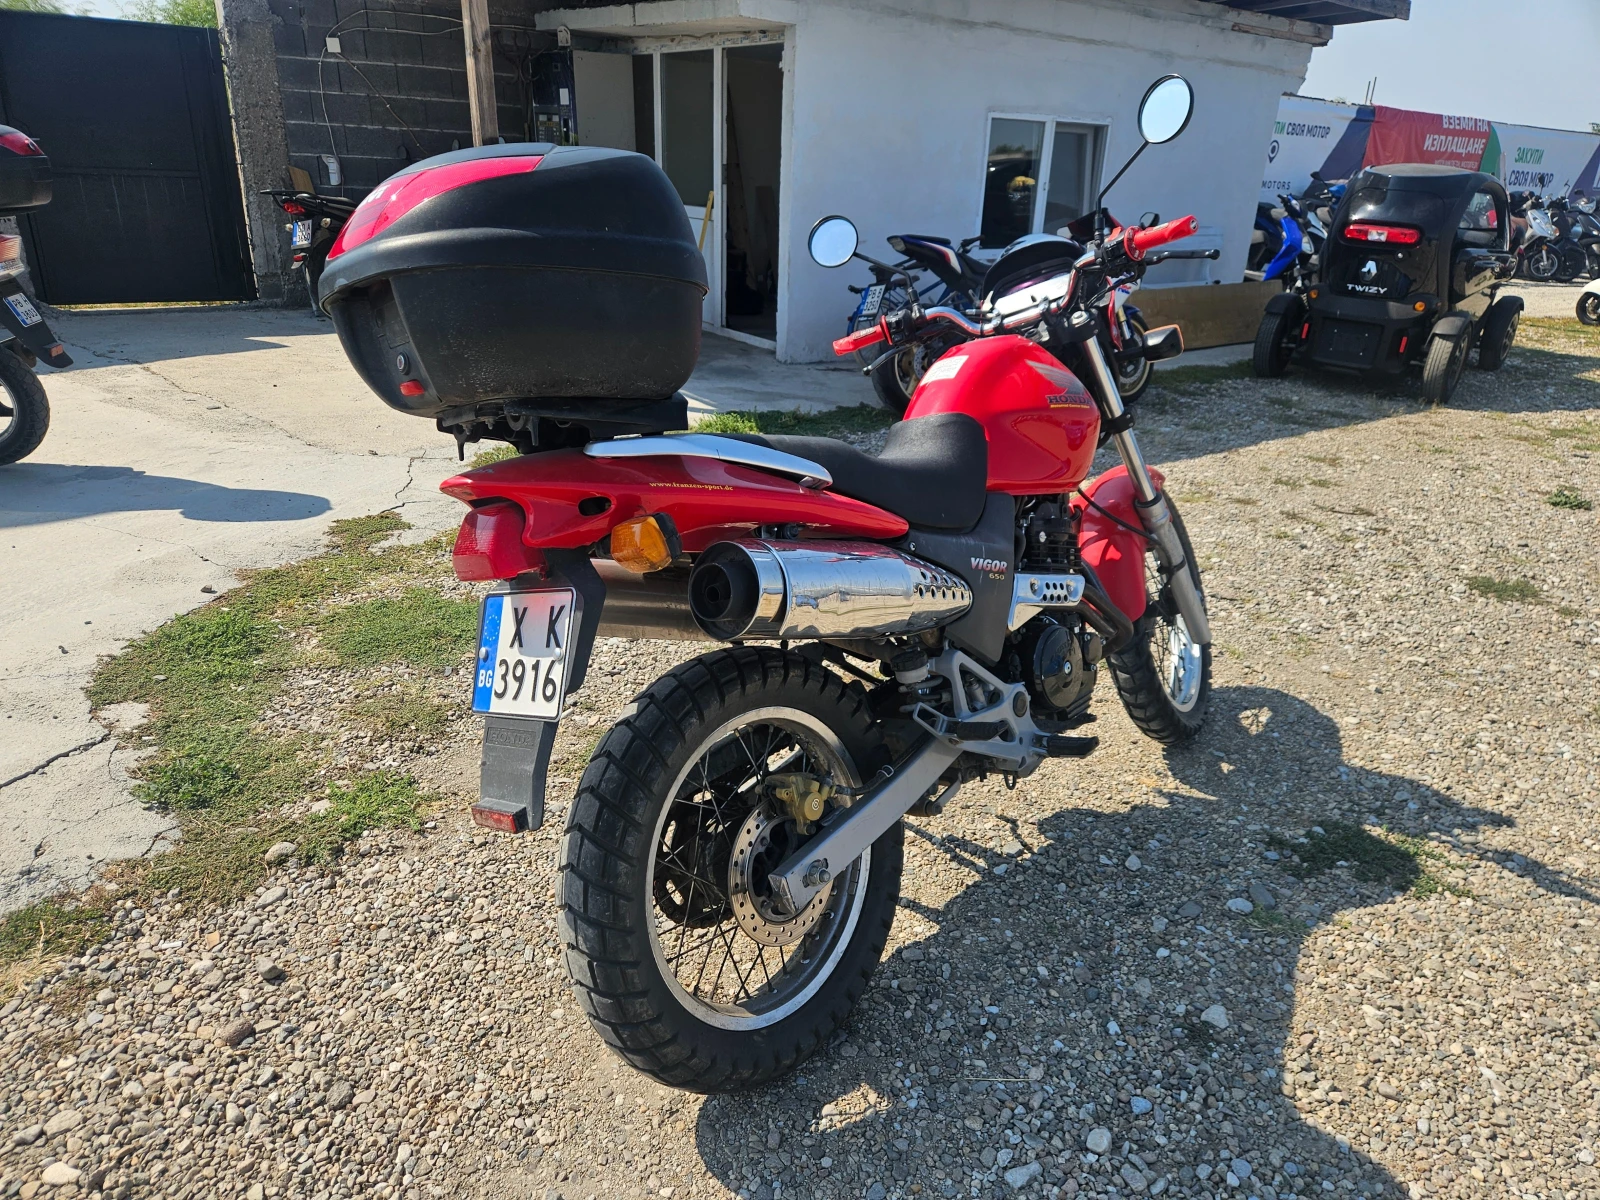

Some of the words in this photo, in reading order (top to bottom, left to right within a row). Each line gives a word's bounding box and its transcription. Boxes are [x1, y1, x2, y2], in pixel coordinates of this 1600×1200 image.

[1286, 122, 1306, 136] СВОЯ
[1305, 124, 1331, 139] МОТОР
[1442, 115, 1475, 131] ВЗЕМИ
[1476, 118, 1489, 132] НА
[1423, 134, 1486, 157] ИЗПЛАЩАНЕ
[1514, 146, 1545, 165] ЗАКУПИ
[1261, 180, 1291, 190] MOTORS
[1508, 169, 1530, 187] СВОЯ
[1346, 283, 1388, 294] TWIZY
[970, 557, 1008, 572] VIGOR
[509, 607, 528, 648] X
[545, 605, 565, 648] K
[478, 669, 493, 688] BG
[493, 658, 557, 703] 3916
